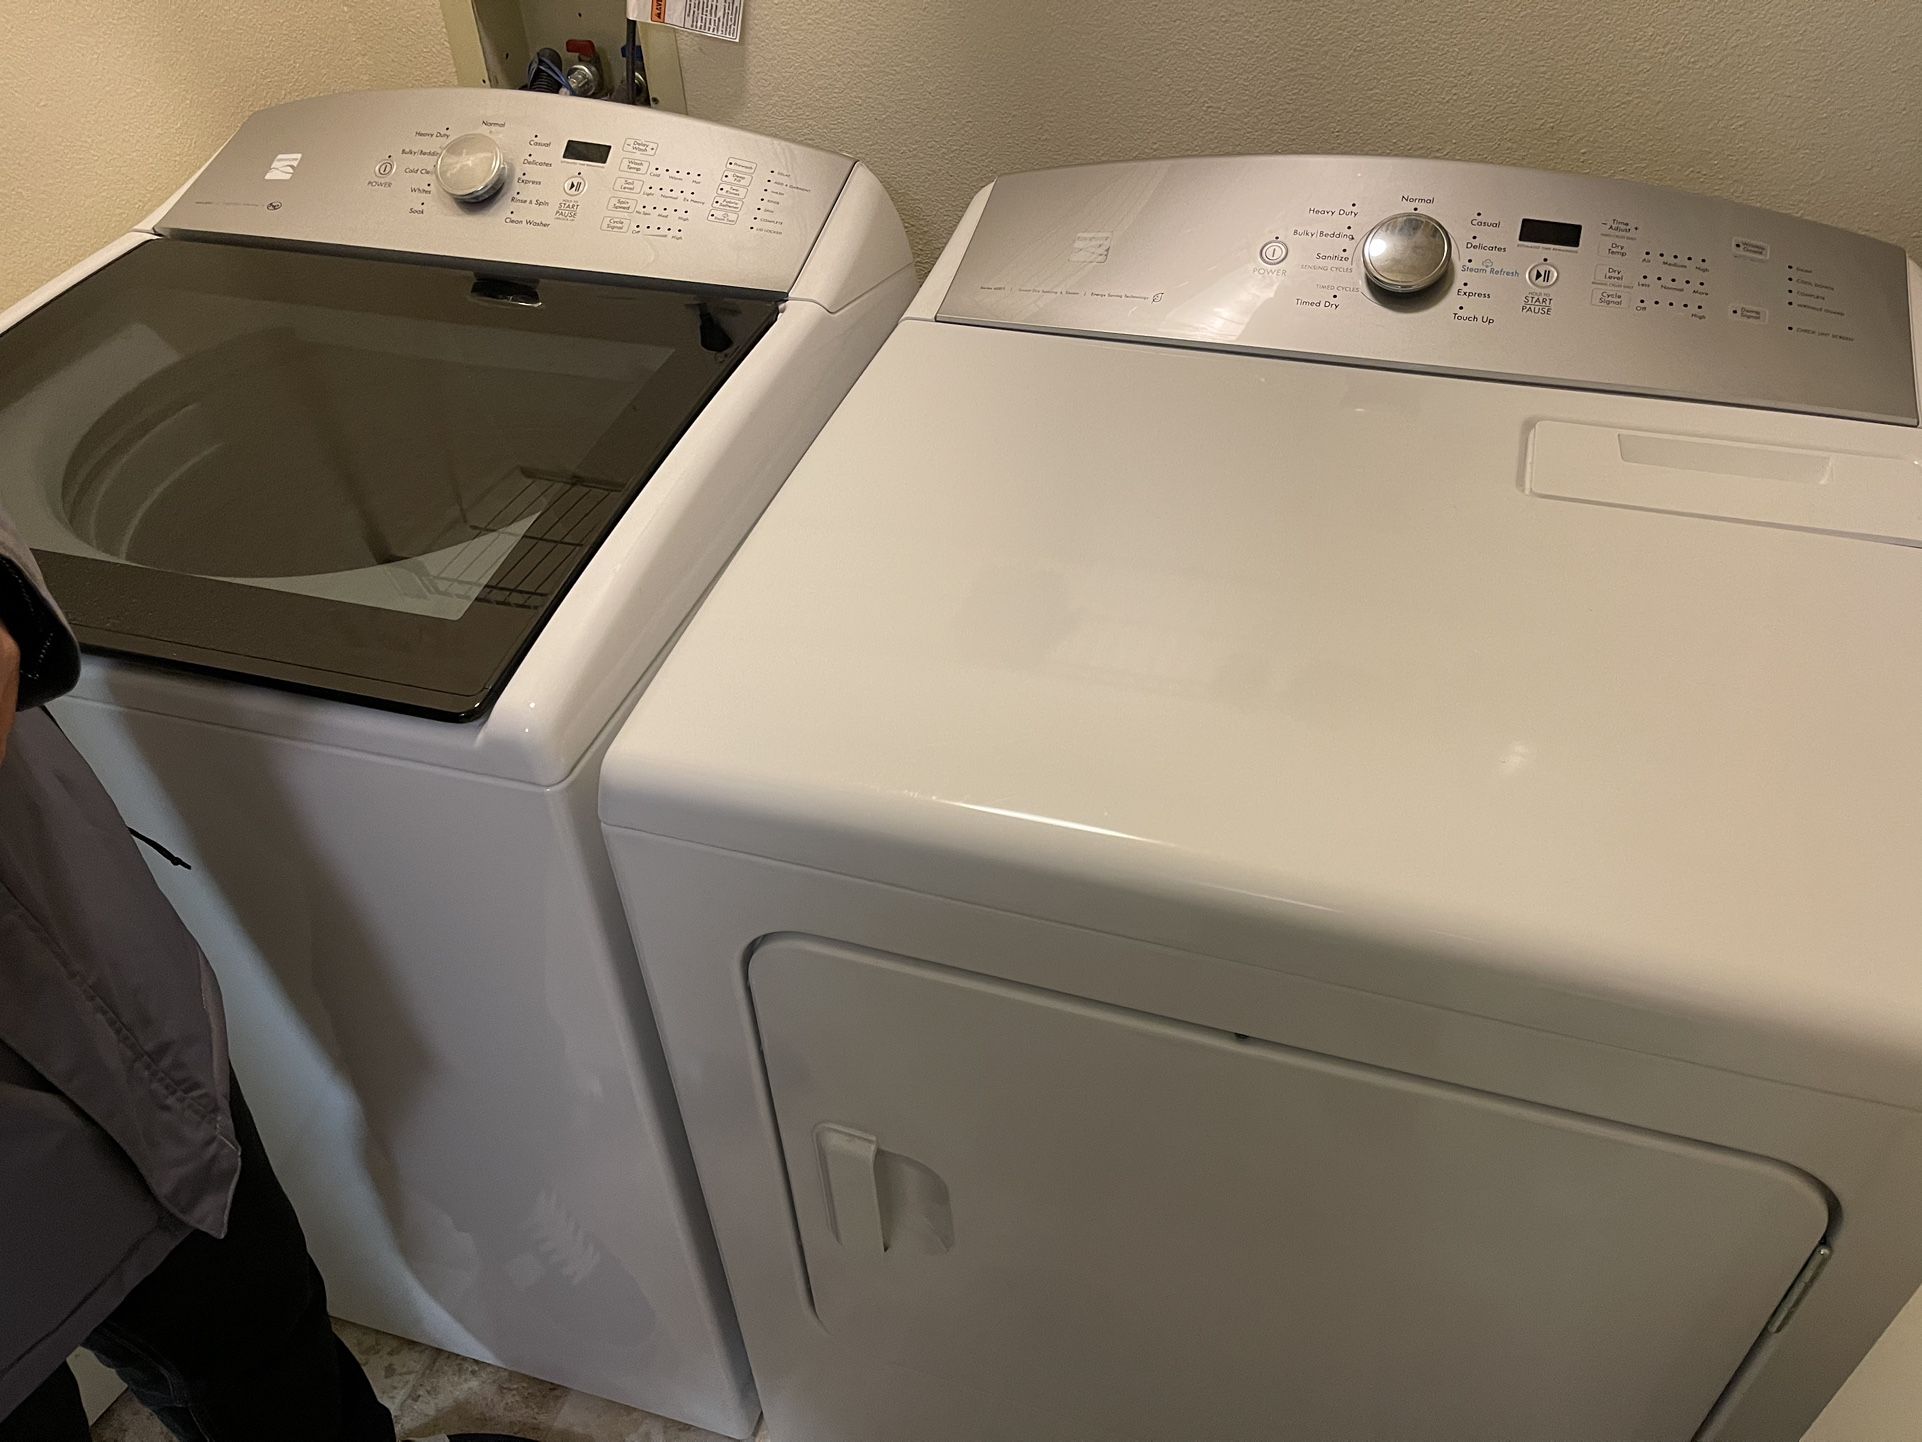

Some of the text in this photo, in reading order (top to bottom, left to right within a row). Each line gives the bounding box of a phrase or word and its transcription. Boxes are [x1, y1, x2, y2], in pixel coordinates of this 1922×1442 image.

[523, 159, 552, 167] Delicates
[517, 177, 542, 186] Express
[1401, 195, 1435, 204] Normal
[1309, 208, 1358, 217] Heavy Duty
[526, 219, 550, 228] Washer
[1470, 219, 1500, 228] Casual
[1608, 225, 1631, 233] Adjust
[1466, 242, 1506, 252] Delicates
[1316, 253, 1349, 262] Sanitize
[1608, 249, 1627, 257] Temp
[1253, 268, 1287, 277] POWER
[1461, 265, 1520, 278] Steam Refresh
[1457, 289, 1491, 299] Express
[1296, 299, 1340, 310] Timed Dry
[1524, 296, 1553, 306] START
[1600, 297, 1622, 306] Signal
[1521, 306, 1552, 315] PAUSE
[1453, 313, 1495, 325] Touch Up
